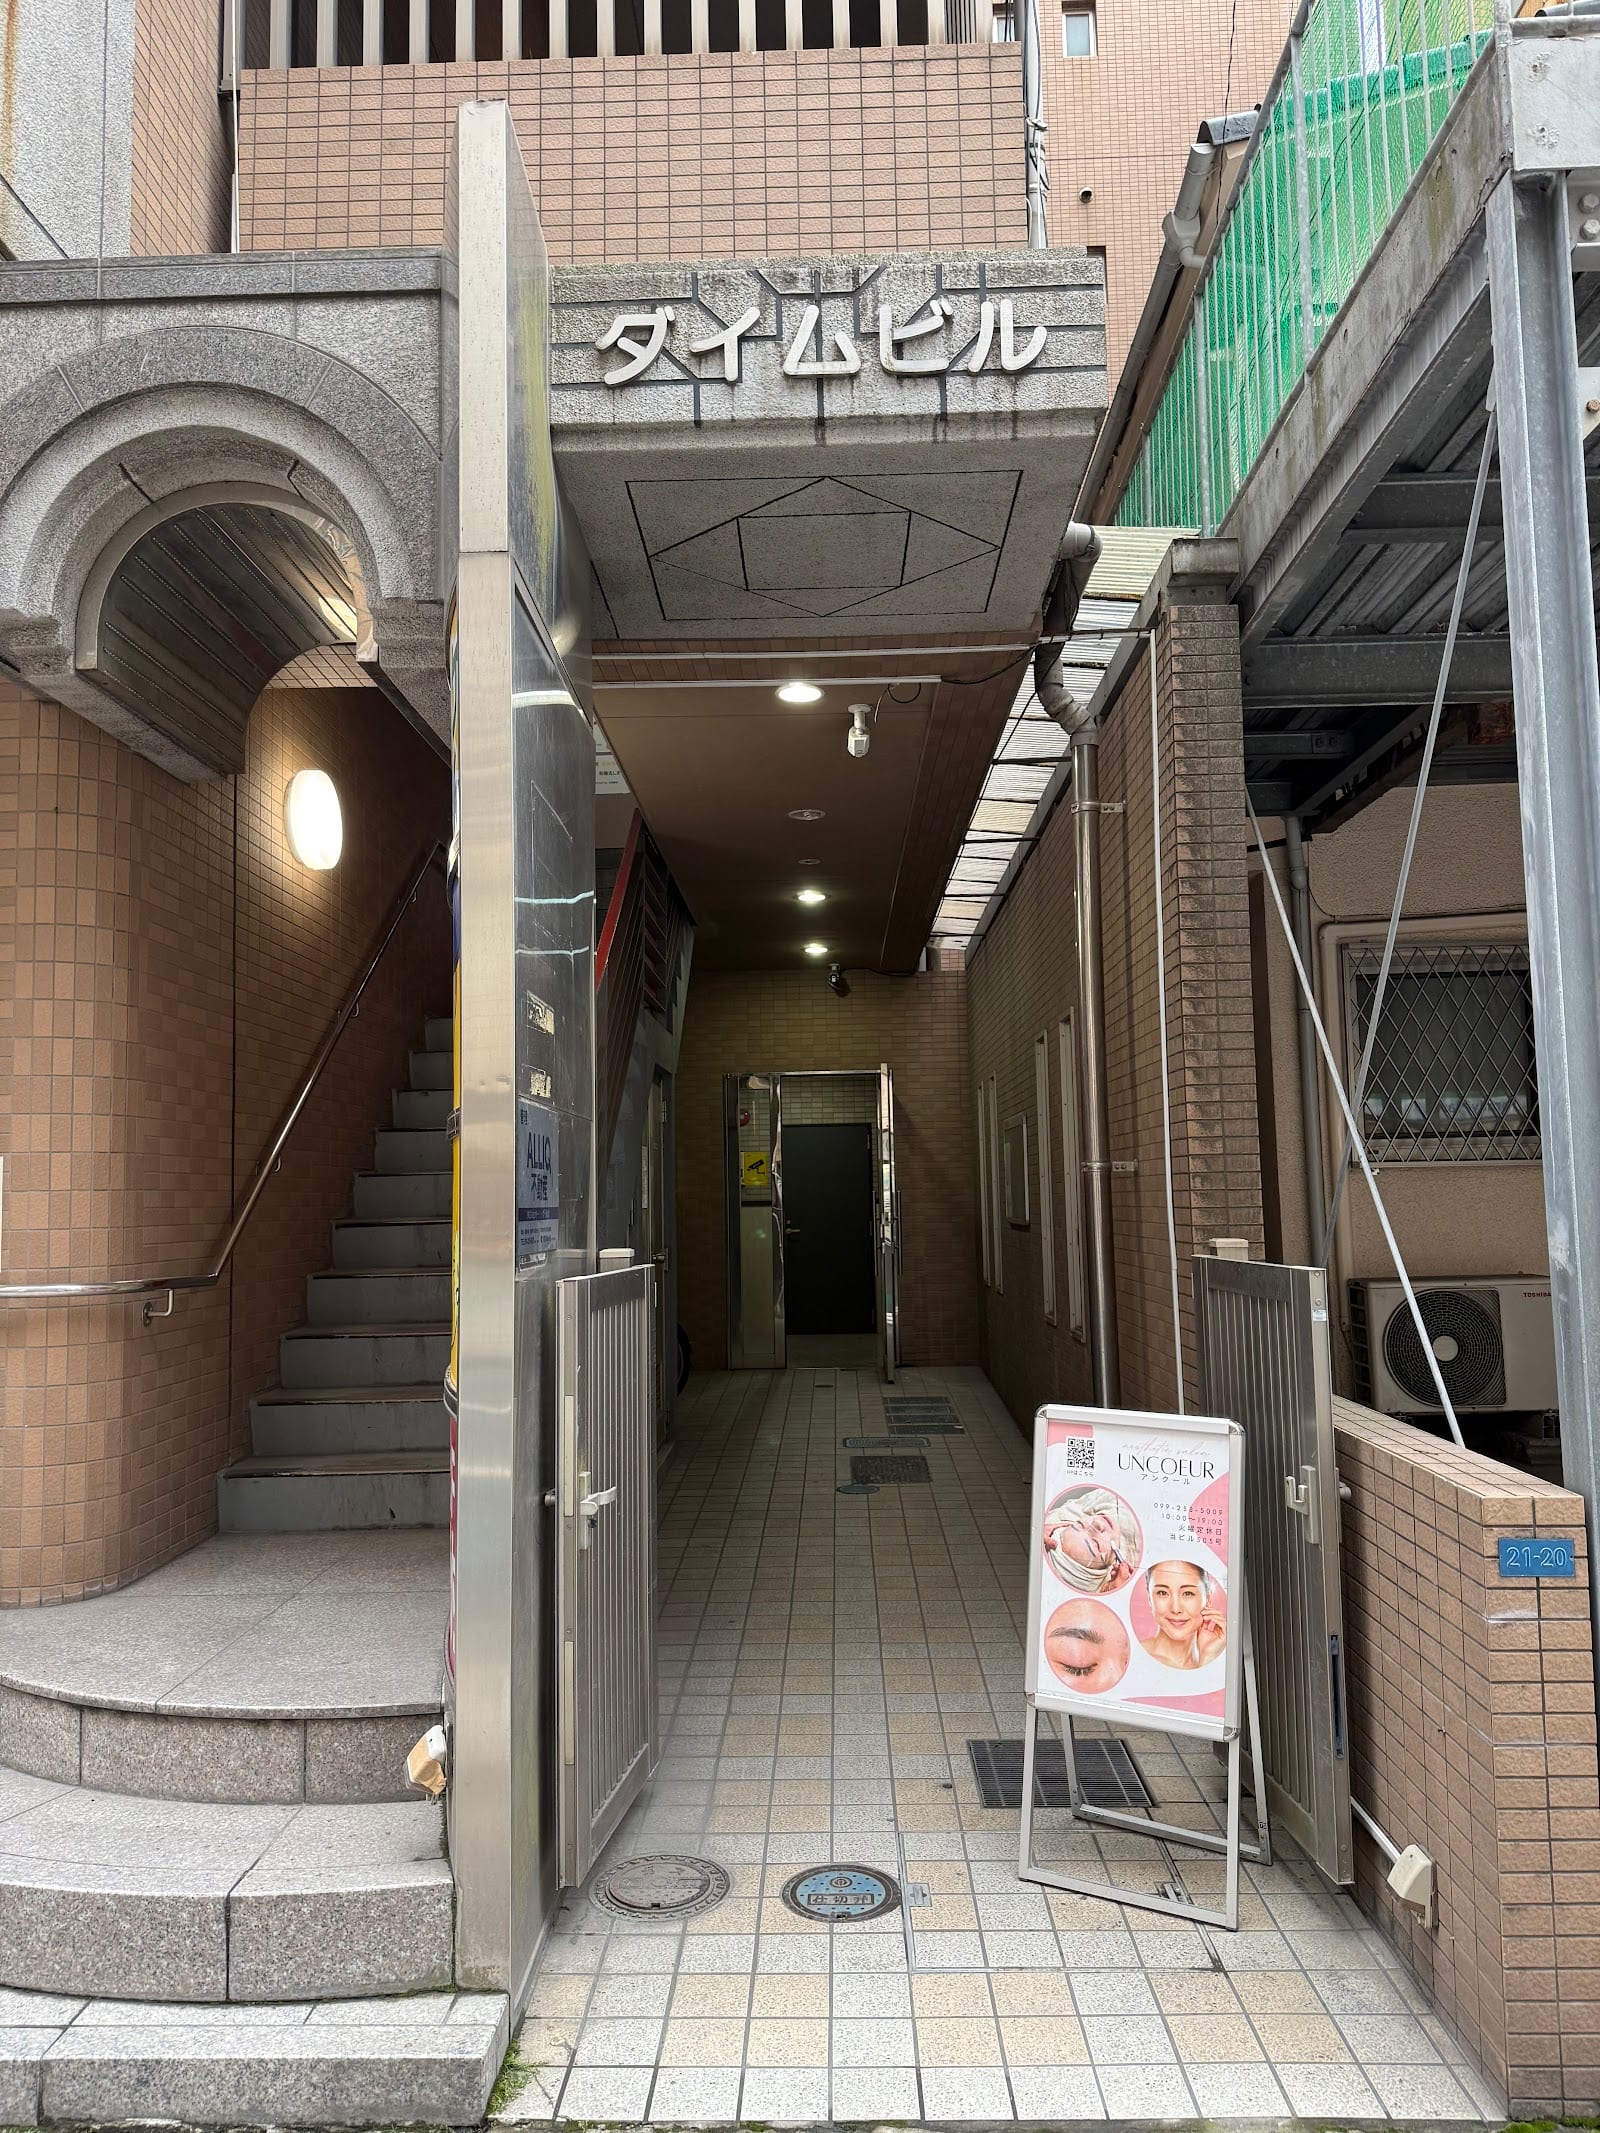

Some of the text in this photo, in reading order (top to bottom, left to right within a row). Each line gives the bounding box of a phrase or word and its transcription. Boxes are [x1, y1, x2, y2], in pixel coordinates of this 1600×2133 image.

[594, 298, 1048, 388] ダイムビル
[531, 1173, 548, 1201] 不動産
[1118, 1452, 1215, 1480] UNCOEUR
[1141, 1474, 1190, 1485] アンクール
[1178, 1524, 1222, 1536] 火曜定休日
[1506, 1546, 1567, 1568] 21-20
